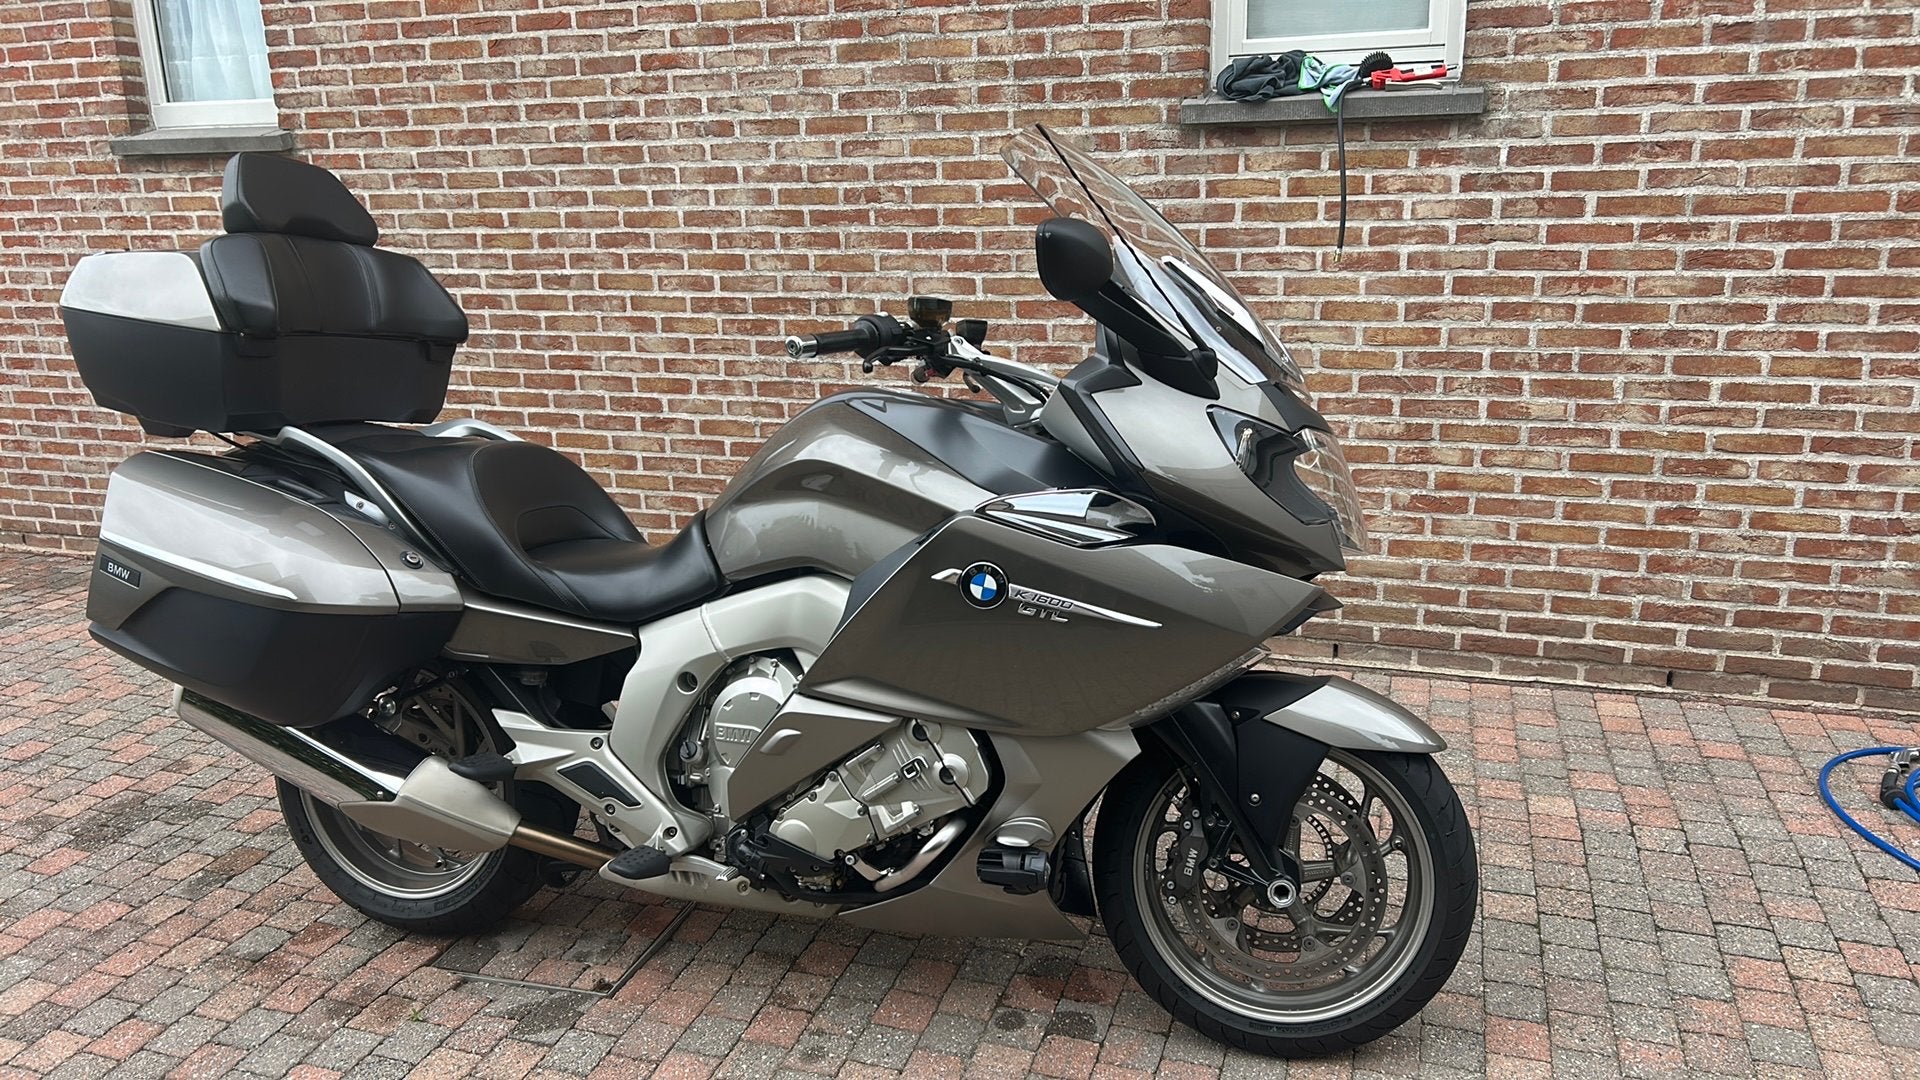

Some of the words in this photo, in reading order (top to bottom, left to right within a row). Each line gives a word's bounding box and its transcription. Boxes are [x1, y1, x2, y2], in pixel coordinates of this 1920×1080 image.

[107, 562, 130, 580] BMW
[1014, 590, 1032, 600] K
[1032, 593, 1073, 609] 1600
[1017, 602, 1068, 622] GTL
[716, 727, 752, 743] BMW
[1184, 847, 1199, 876] BMW
